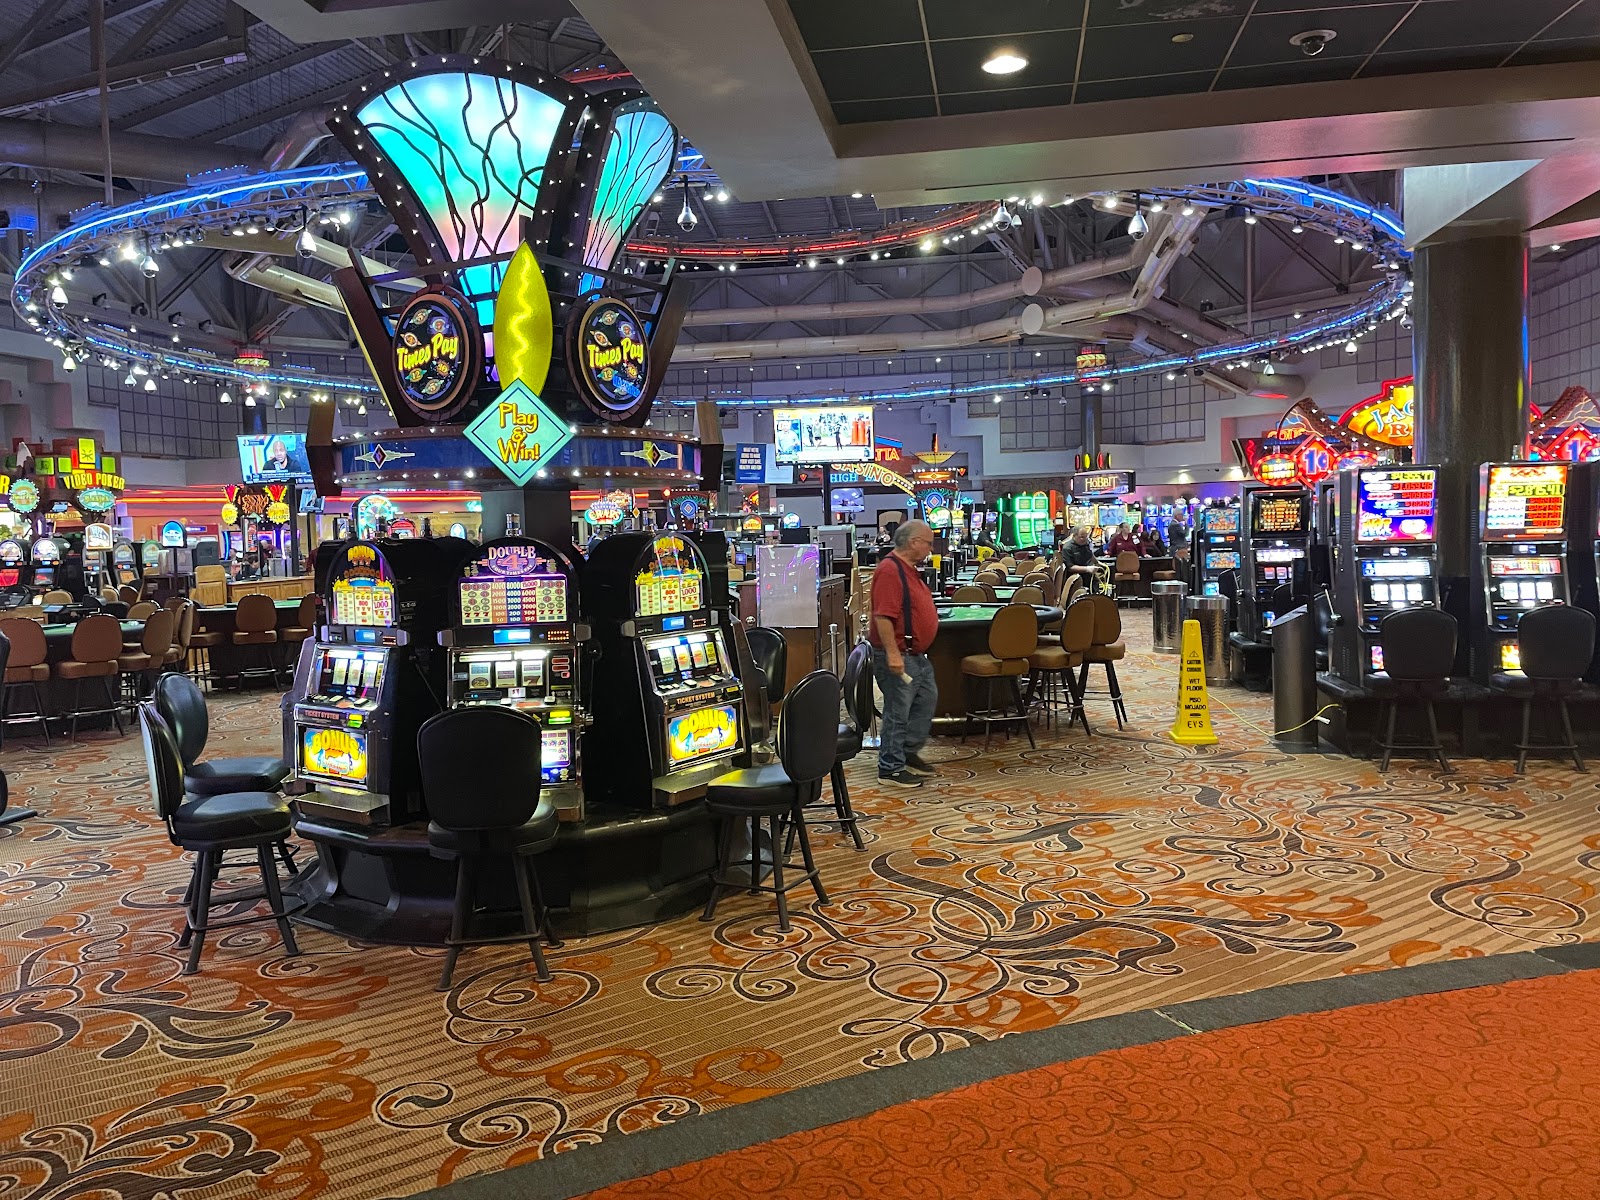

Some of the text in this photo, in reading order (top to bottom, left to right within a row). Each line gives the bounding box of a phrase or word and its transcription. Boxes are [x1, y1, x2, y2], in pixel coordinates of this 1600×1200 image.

[397, 332, 459, 371] Times Pay
[587, 337, 644, 368] Times Pay
[499, 402, 539, 433] Play
[511, 426, 527, 442] &
[497, 437, 541, 463] Win!
[63, 472, 126, 491] VIDEO POKER
[830, 473, 859, 483] HIGH
[831, 462, 895, 486] CASINO
[488, 545, 537, 560] DOUBLE
[501, 553, 521, 571] 4
[677, 691, 716, 705] TICKET SYSTEM
[304, 709, 340, 720] TICKET SYSTEM
[678, 708, 729, 744] BONUS
[311, 729, 360, 760] BONUS
